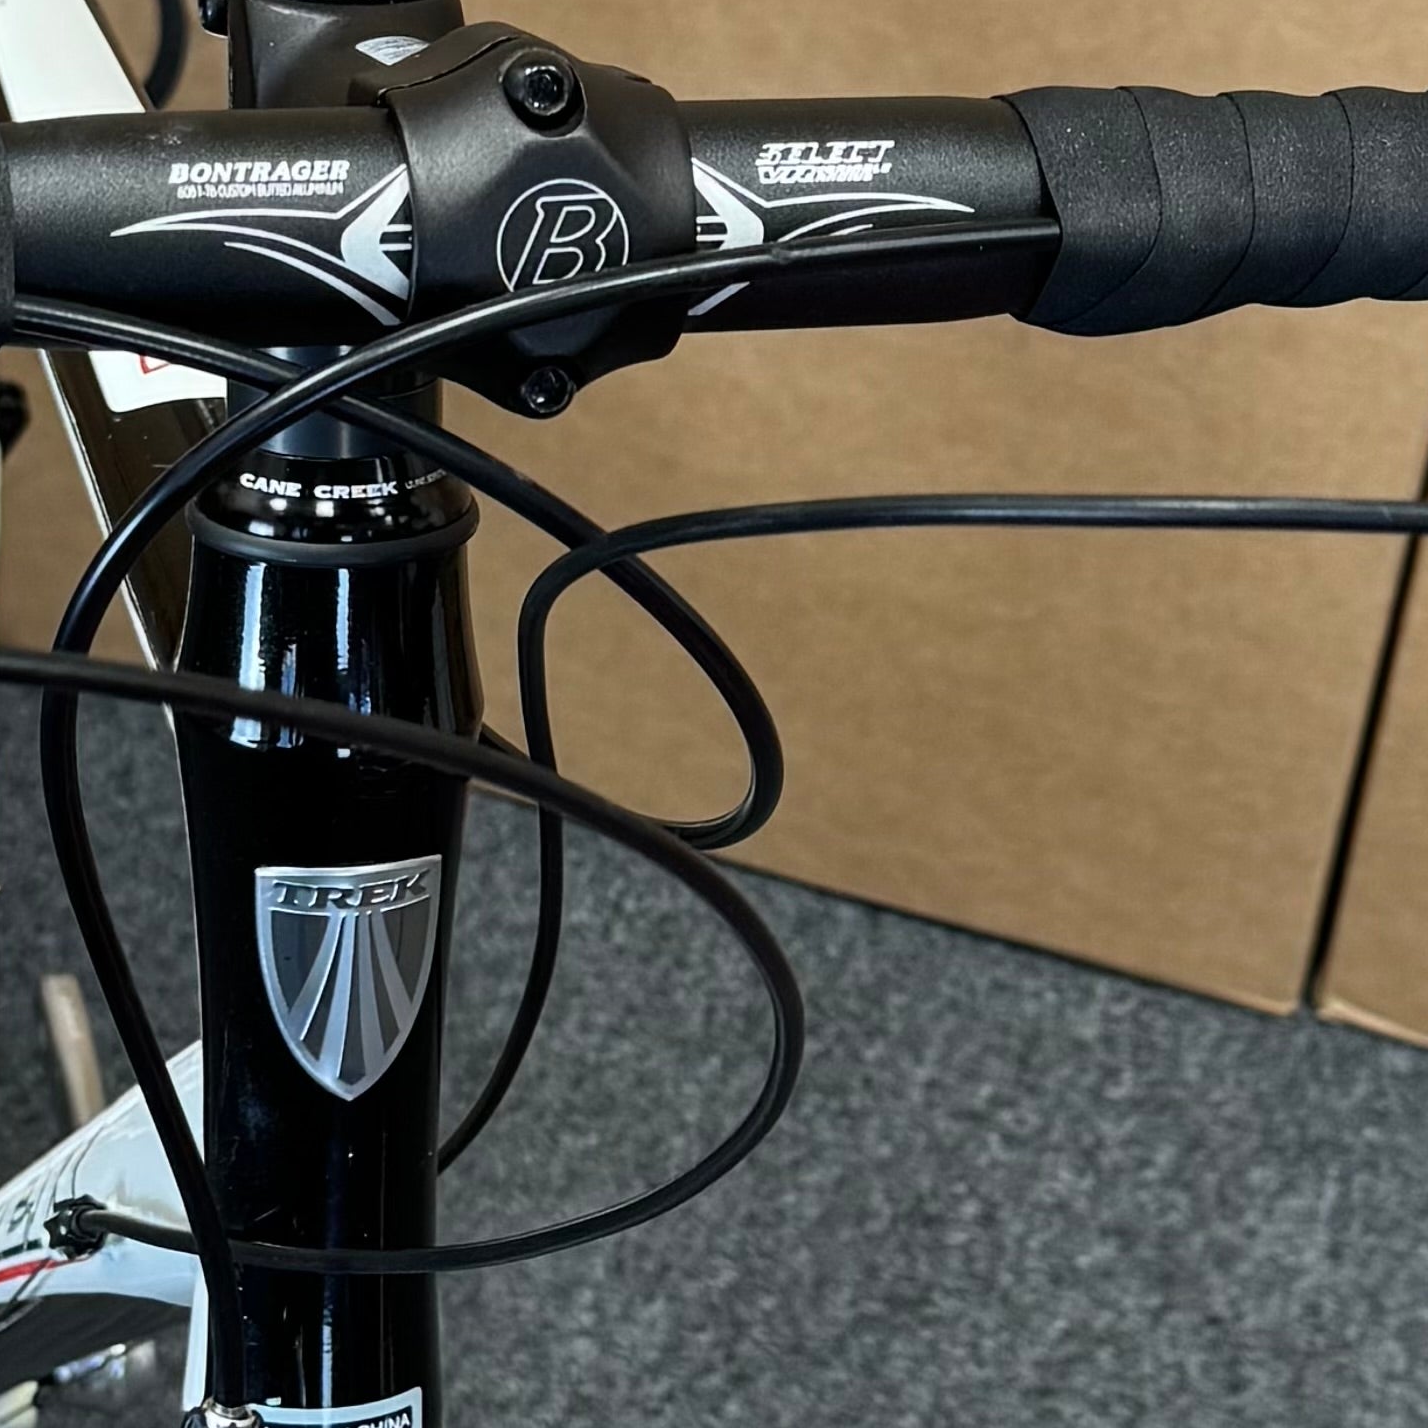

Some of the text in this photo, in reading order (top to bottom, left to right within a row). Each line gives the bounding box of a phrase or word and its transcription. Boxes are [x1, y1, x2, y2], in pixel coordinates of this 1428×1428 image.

[168, 160, 350, 184] BONTRAGER
[239, 473, 398, 499] CANE CREEK
[272, 870, 429, 911] TREK
